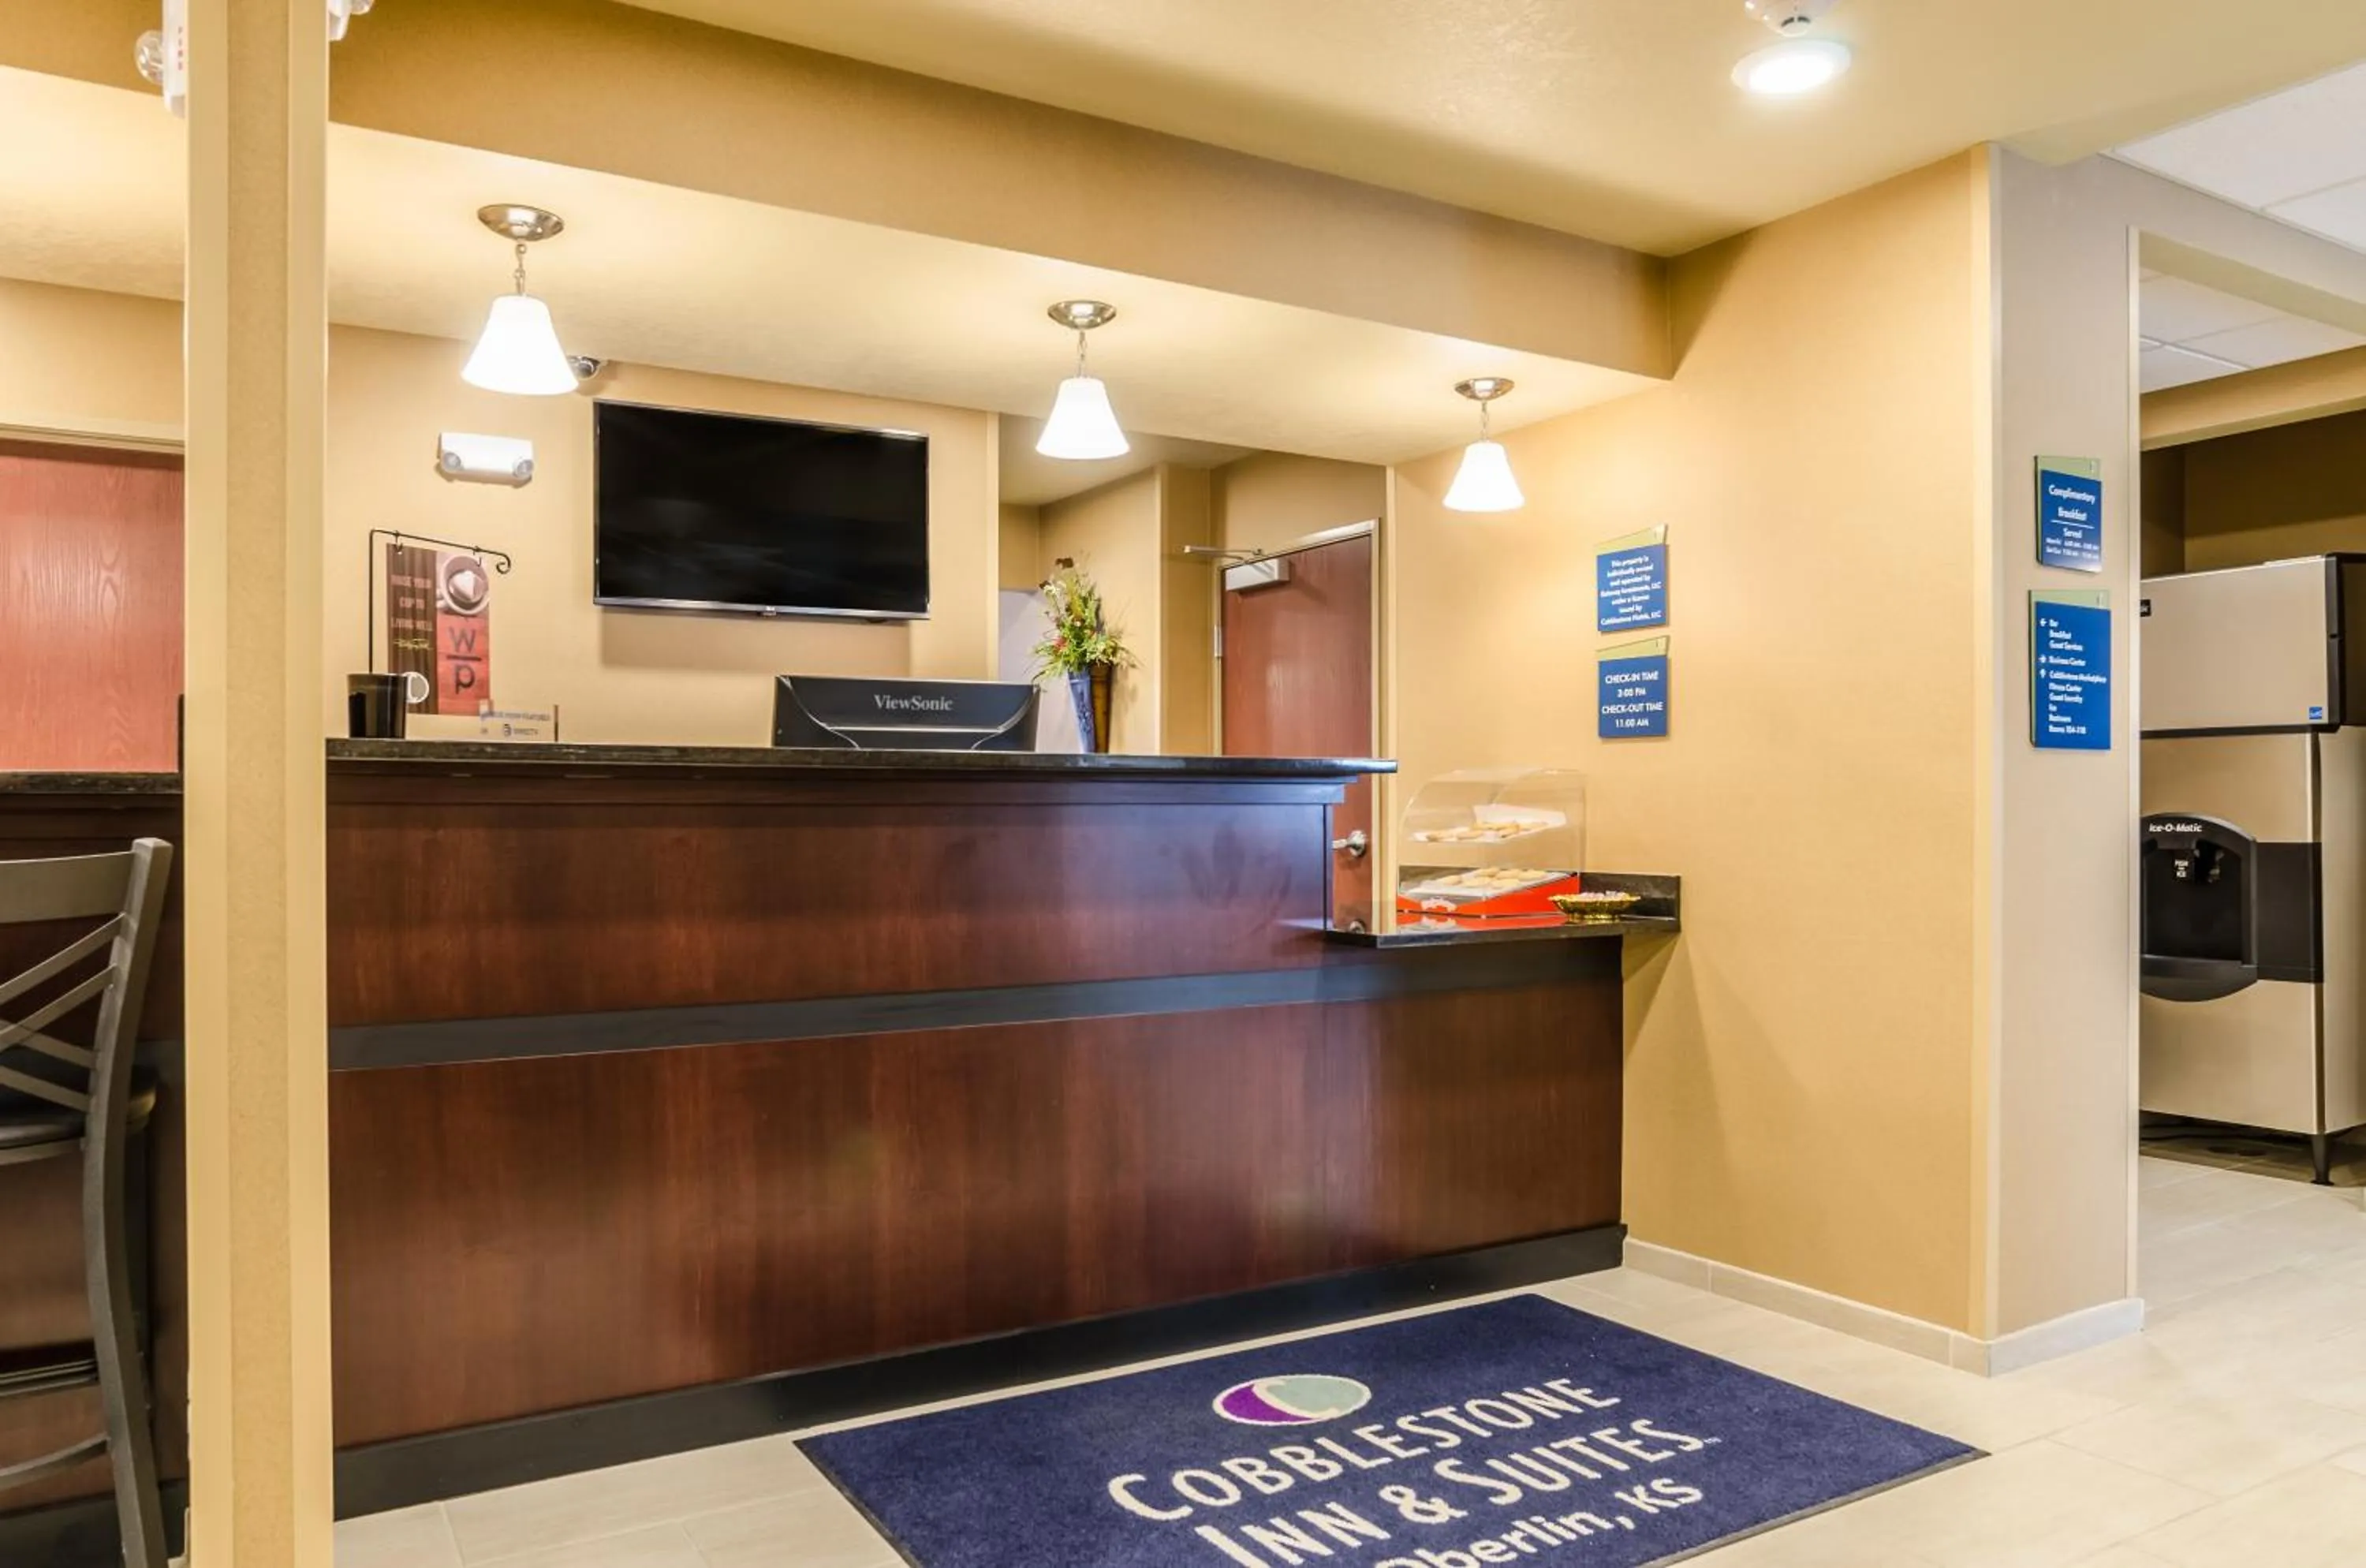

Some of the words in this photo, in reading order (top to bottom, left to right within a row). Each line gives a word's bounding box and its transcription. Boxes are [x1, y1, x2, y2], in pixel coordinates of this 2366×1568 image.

[2058, 506, 2088, 521] Breakfast
[1605, 674, 1640, 685] CHECK-IN
[1641, 670, 1659, 681] TIME
[873, 694, 953, 711] ViewSonic
[1602, 704, 1644, 714] CHECK-OUT
[1646, 701, 1663, 711] TIME
[2148, 823, 2203, 833] Ice-O-Matic
[1108, 1377, 1621, 1521] COBBLESTONE
[1195, 1501, 1391, 1568] INN
[1379, 1485, 1468, 1525] &
[1434, 1419, 1704, 1505] SUITES
[1614, 1478, 1704, 1514] KS
